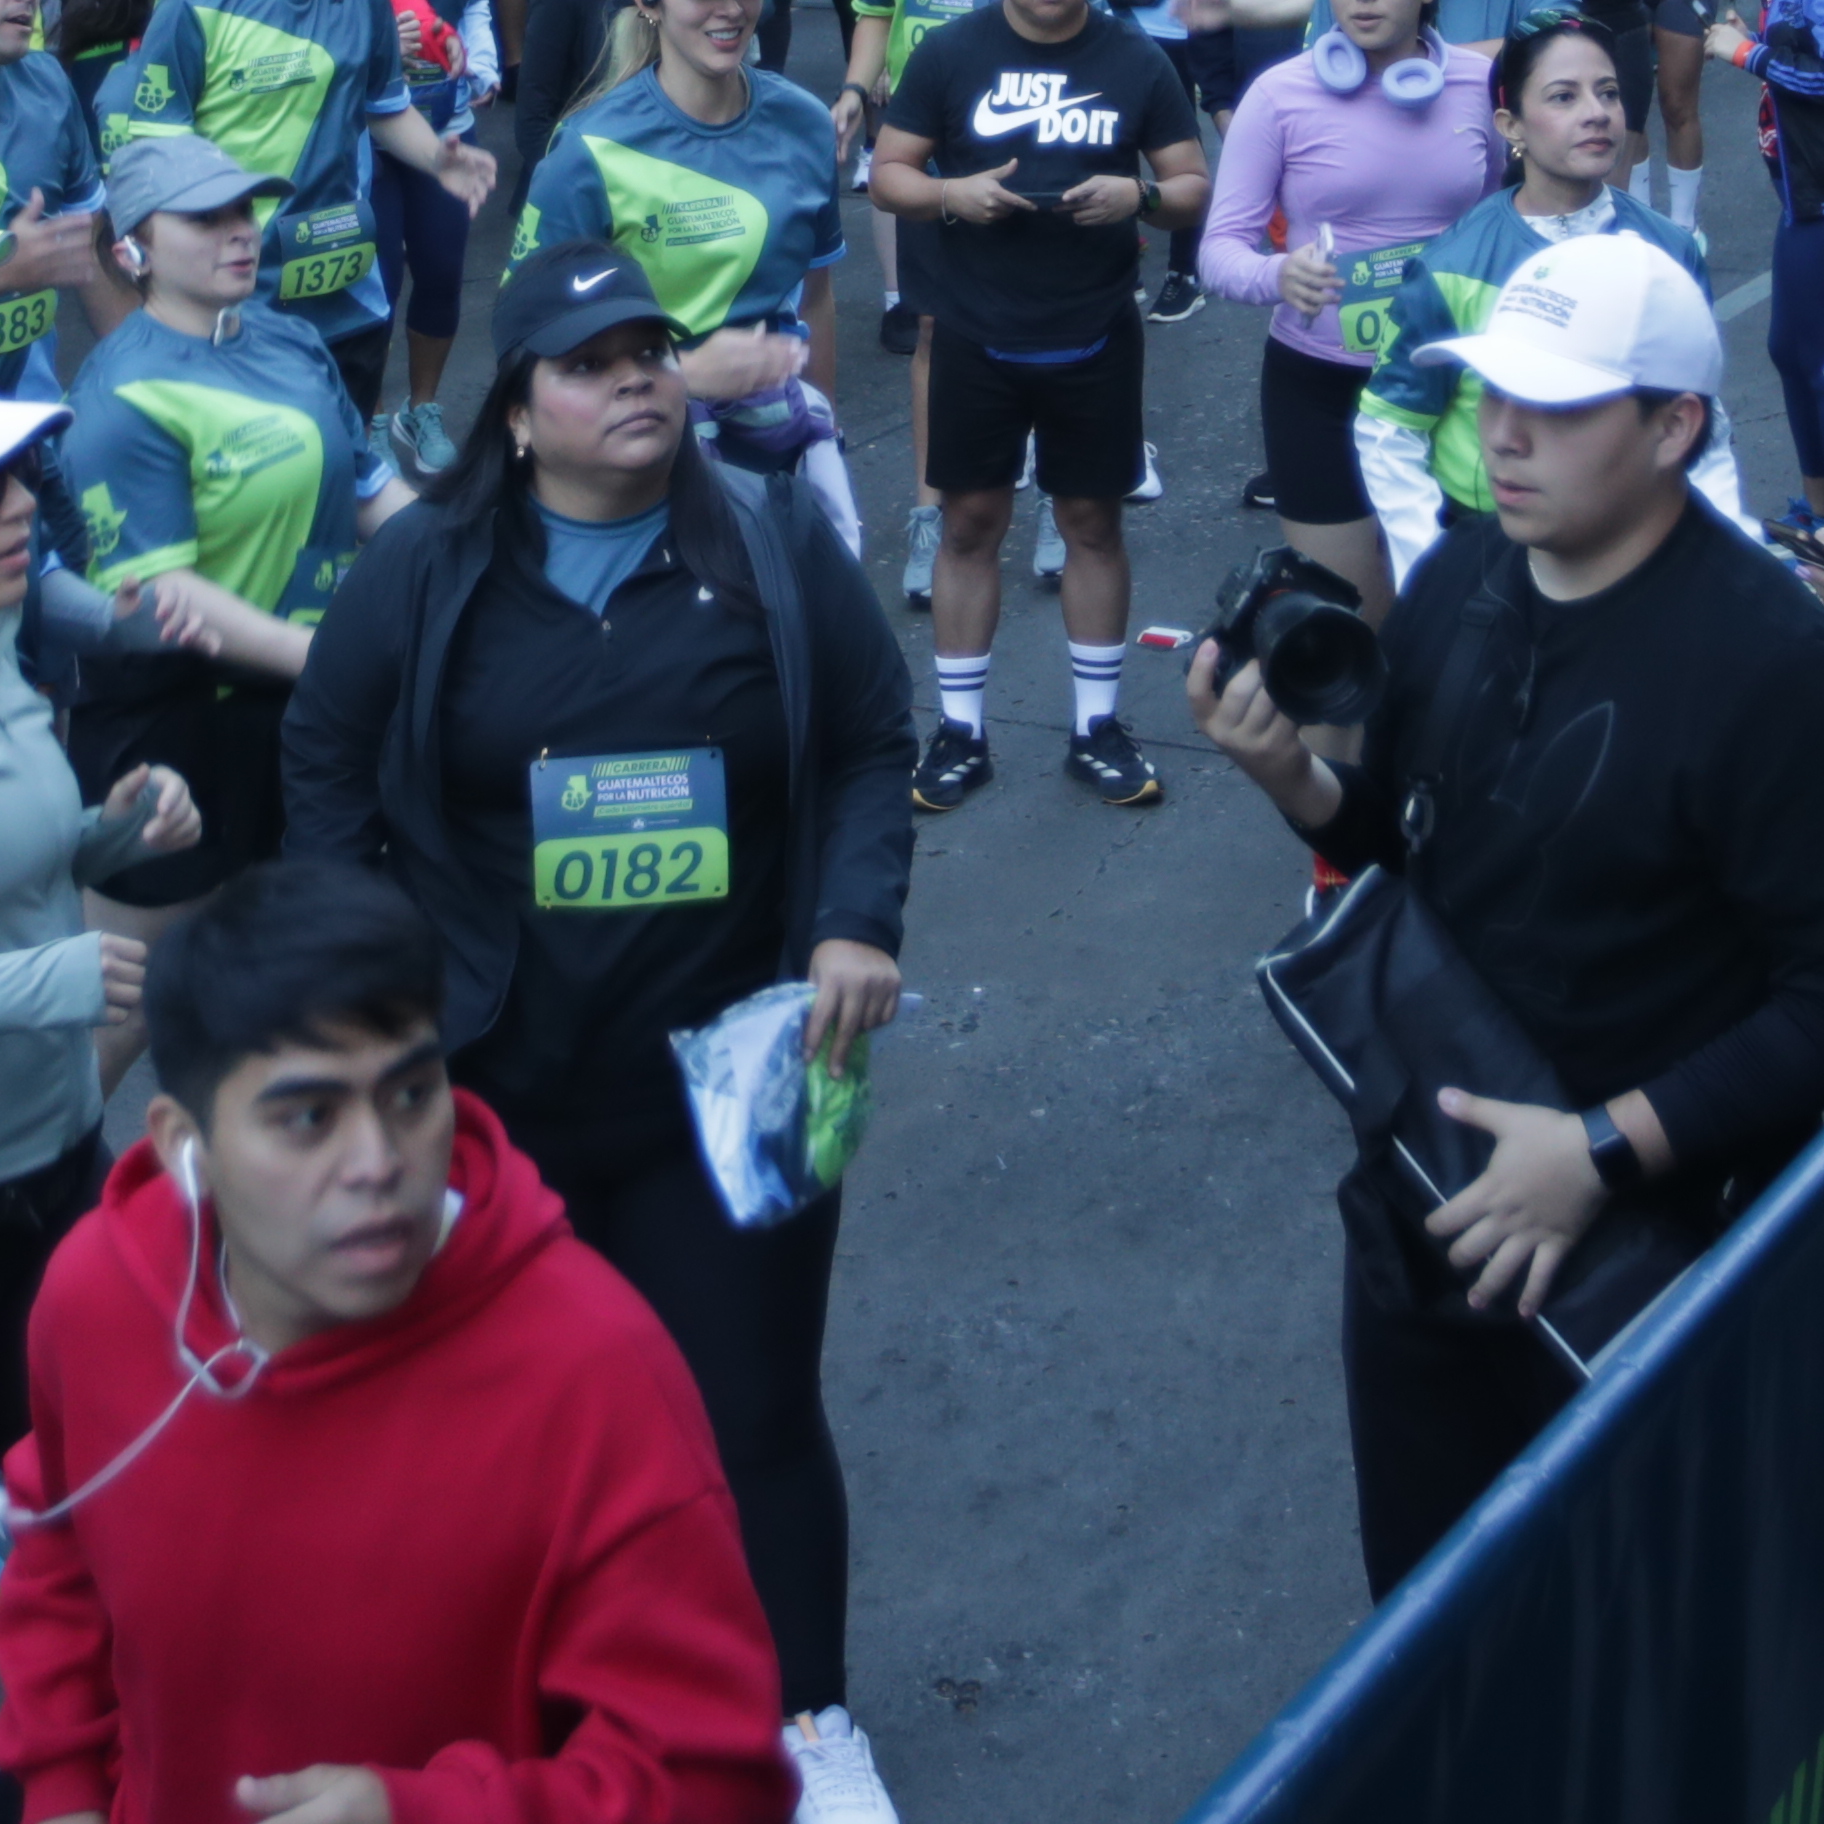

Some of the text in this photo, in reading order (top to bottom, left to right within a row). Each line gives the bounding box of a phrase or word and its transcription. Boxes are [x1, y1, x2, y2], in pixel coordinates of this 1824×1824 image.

[991, 72, 1068, 107] JUST
[1037, 108, 1120, 145] DO IT
[667, 208, 738, 226] GUATEMALTECOS
[692, 216, 741, 232] NUTRICIÓN
[293, 250, 364, 295] 1373
[612, 759, 669, 774] CARRERA
[596, 773, 689, 792] GUATEMALTECOS
[597, 783, 690, 802] POR LA NUTRICIÓN
[553, 840, 704, 901] 0182
